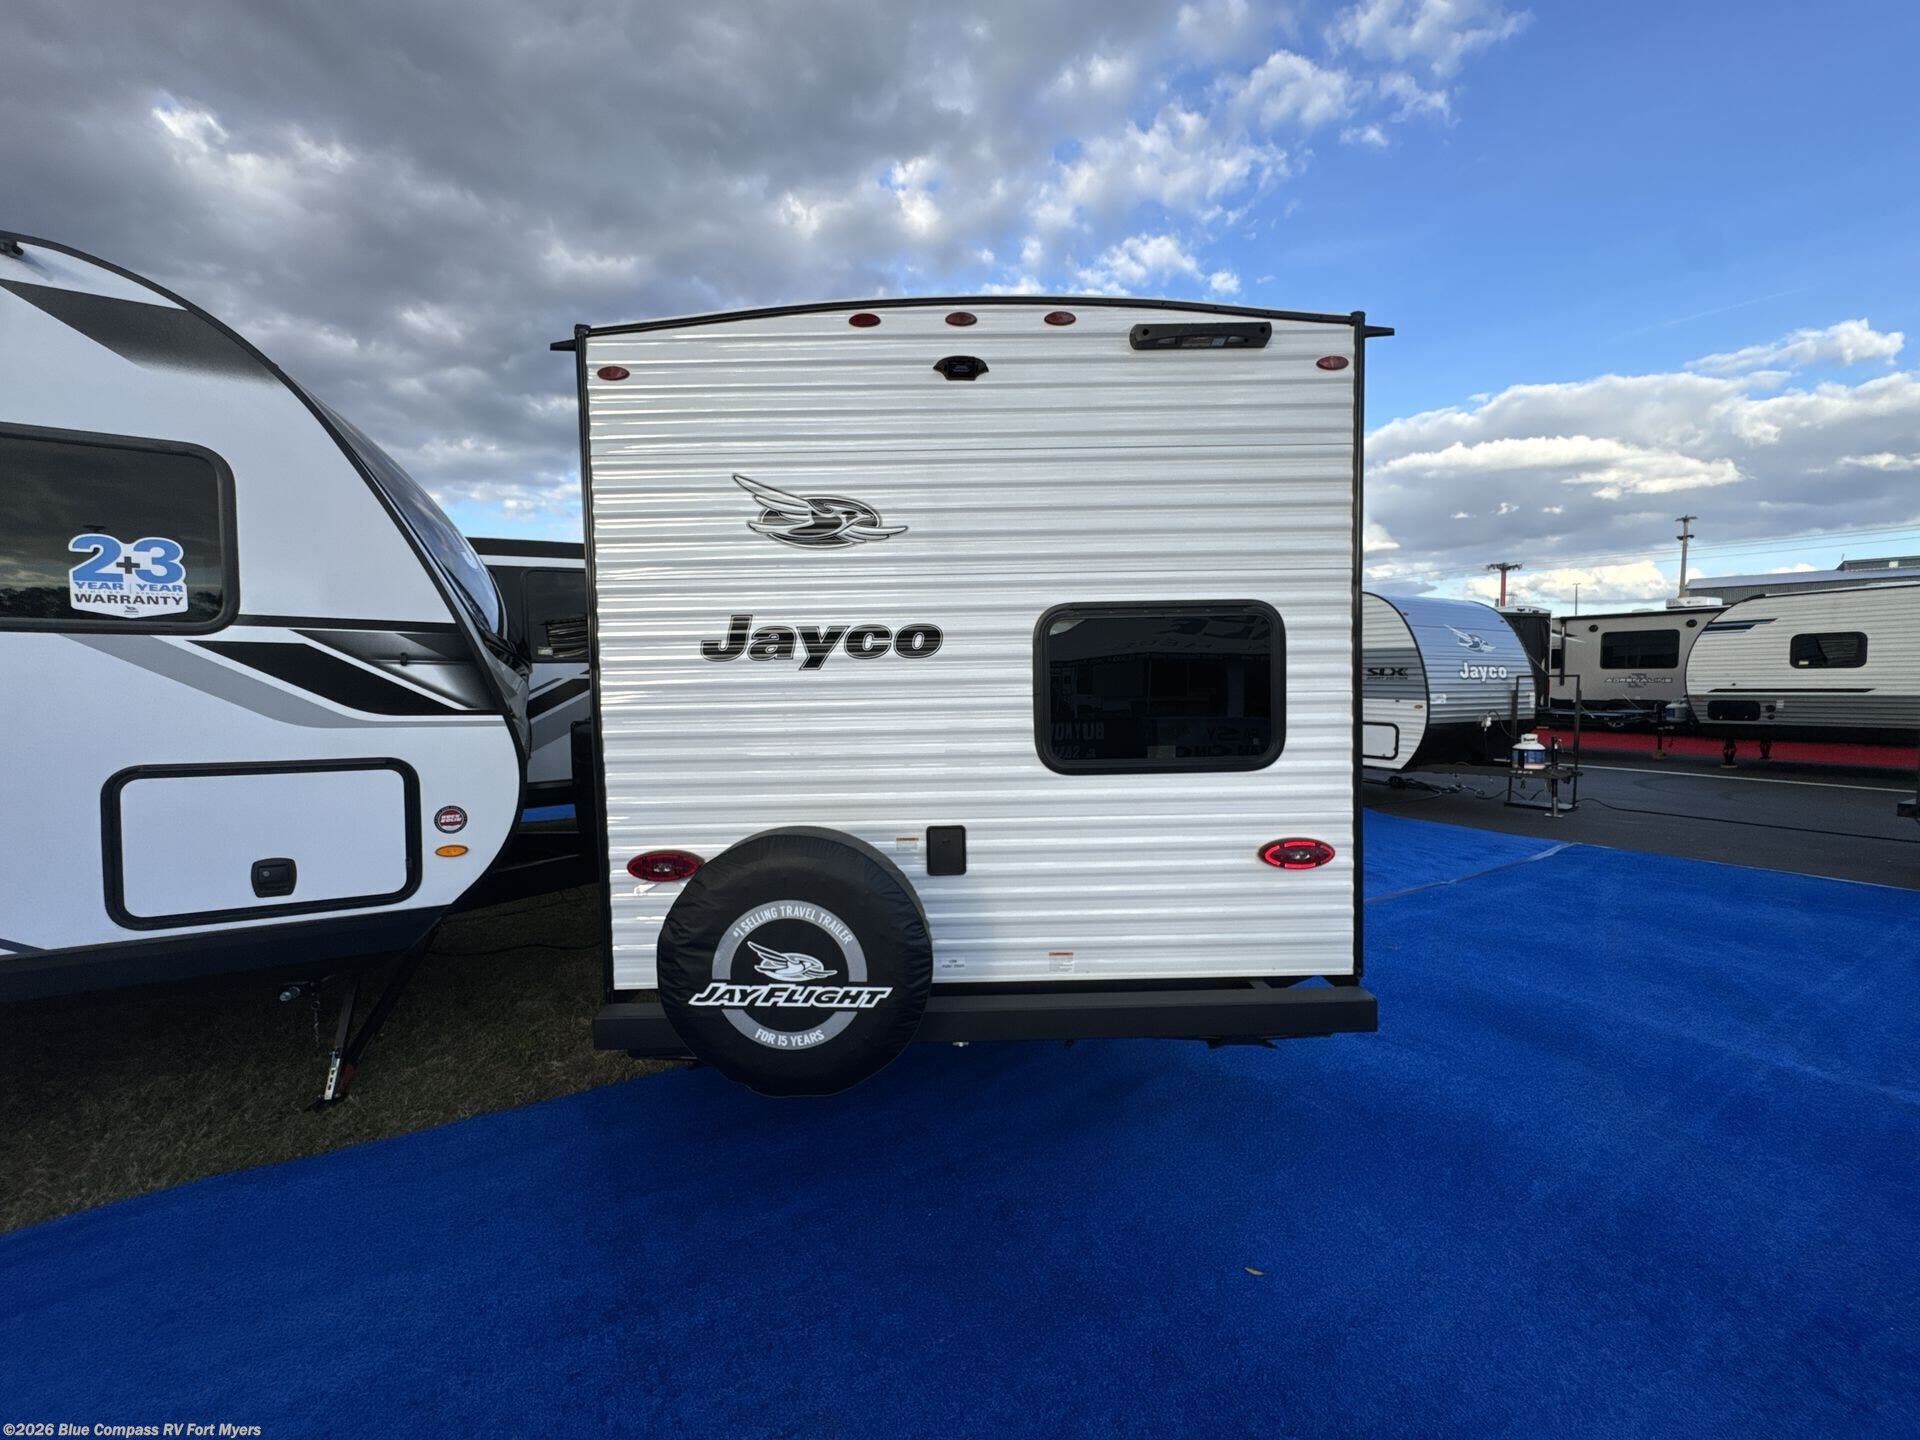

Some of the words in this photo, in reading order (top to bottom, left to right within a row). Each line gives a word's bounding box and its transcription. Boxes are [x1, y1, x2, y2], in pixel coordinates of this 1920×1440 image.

[74, 581, 124, 591] YEAR
[136, 583, 183, 592] YEAR
[74, 593, 183, 606] WARRANTY
[700, 614, 944, 671] Jayco
[1366, 667, 1408, 677] SLX
[1459, 660, 1508, 683] Jayco
[740, 907, 778, 932] SELLING
[779, 905, 816, 920] TRAVEL
[817, 912, 854, 944] TRAILER
[755, 1028, 775, 1045] FOR
[777, 1032, 788, 1047] 15
[790, 1029, 825, 1047] YEARS
